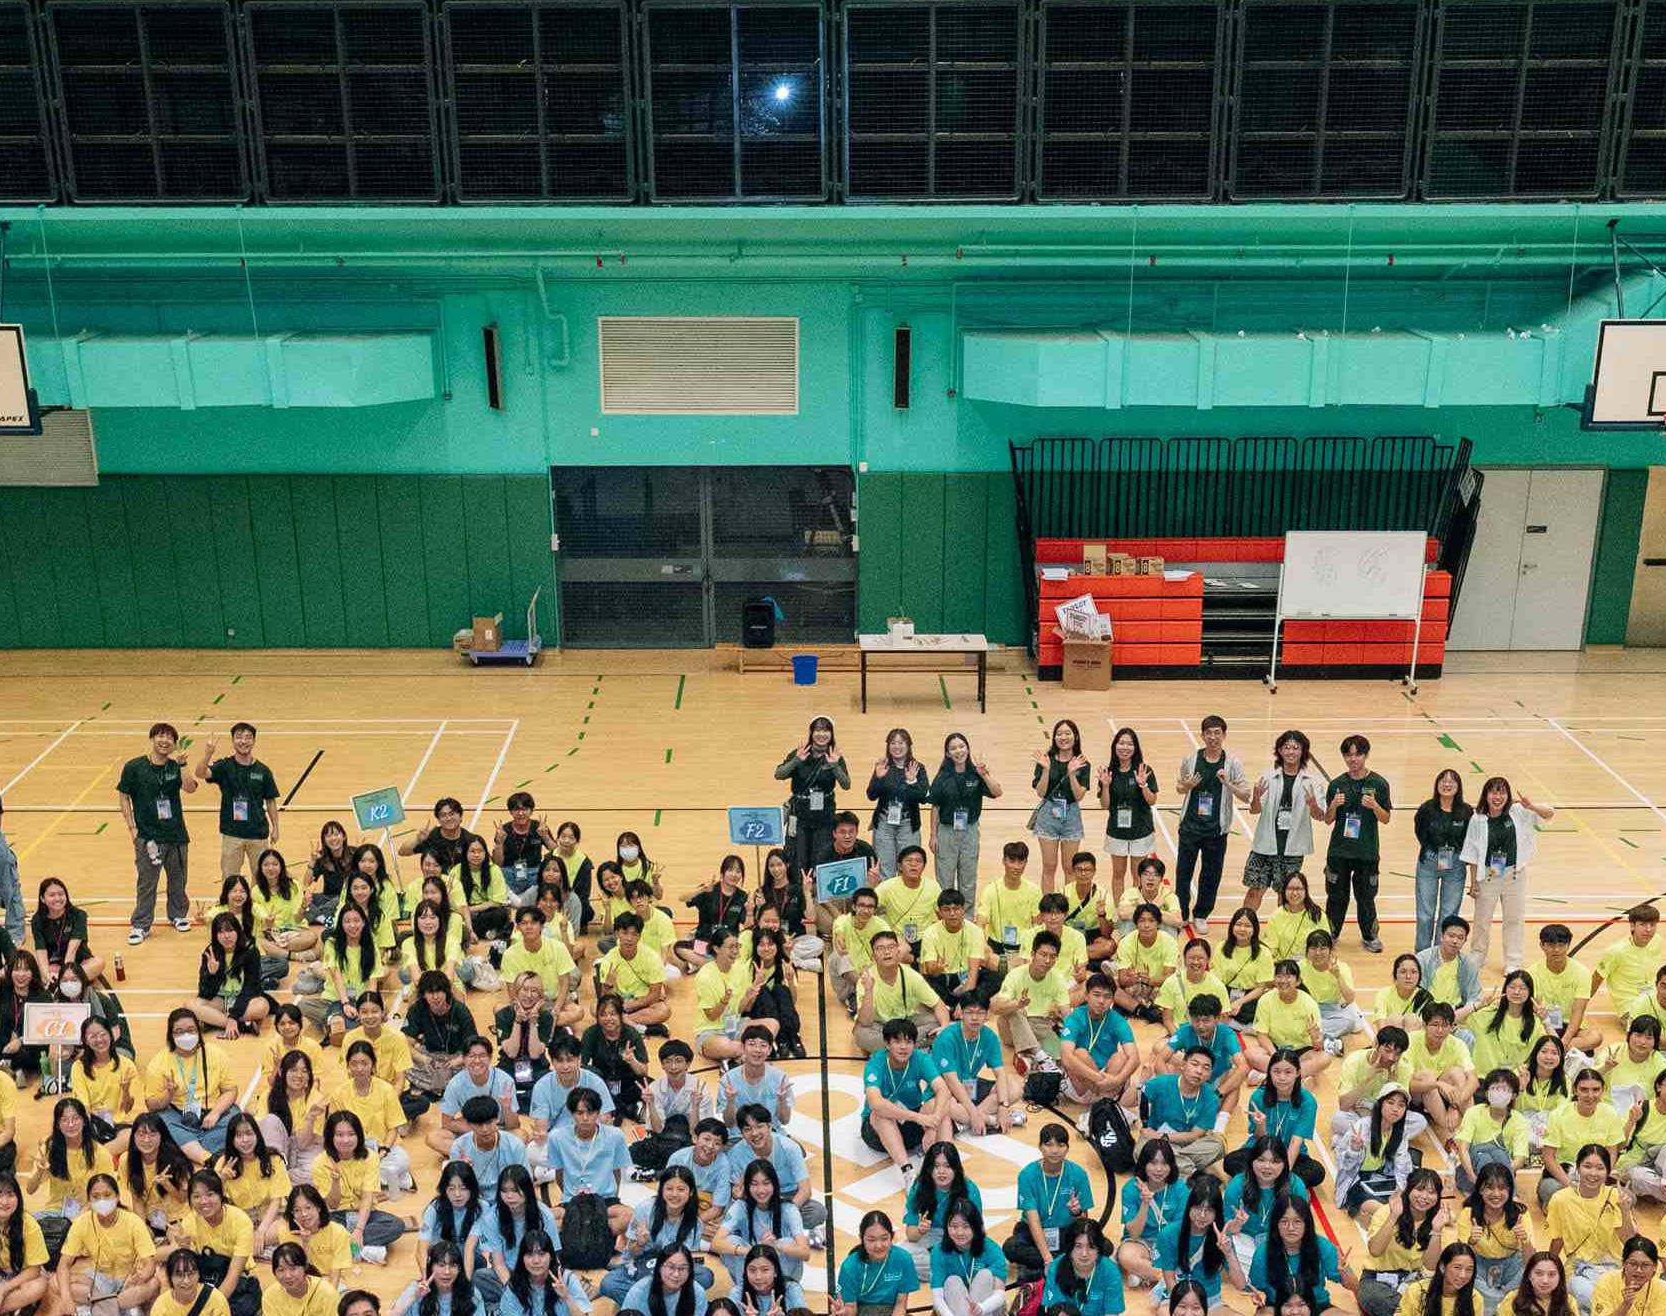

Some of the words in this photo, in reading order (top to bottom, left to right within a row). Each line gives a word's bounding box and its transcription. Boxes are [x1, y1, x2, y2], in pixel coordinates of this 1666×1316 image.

[370, 803, 390, 822] K2
[745, 822, 766, 839] F2
[833, 877, 850, 894] F1
[44, 1020, 67, 1037] C1
